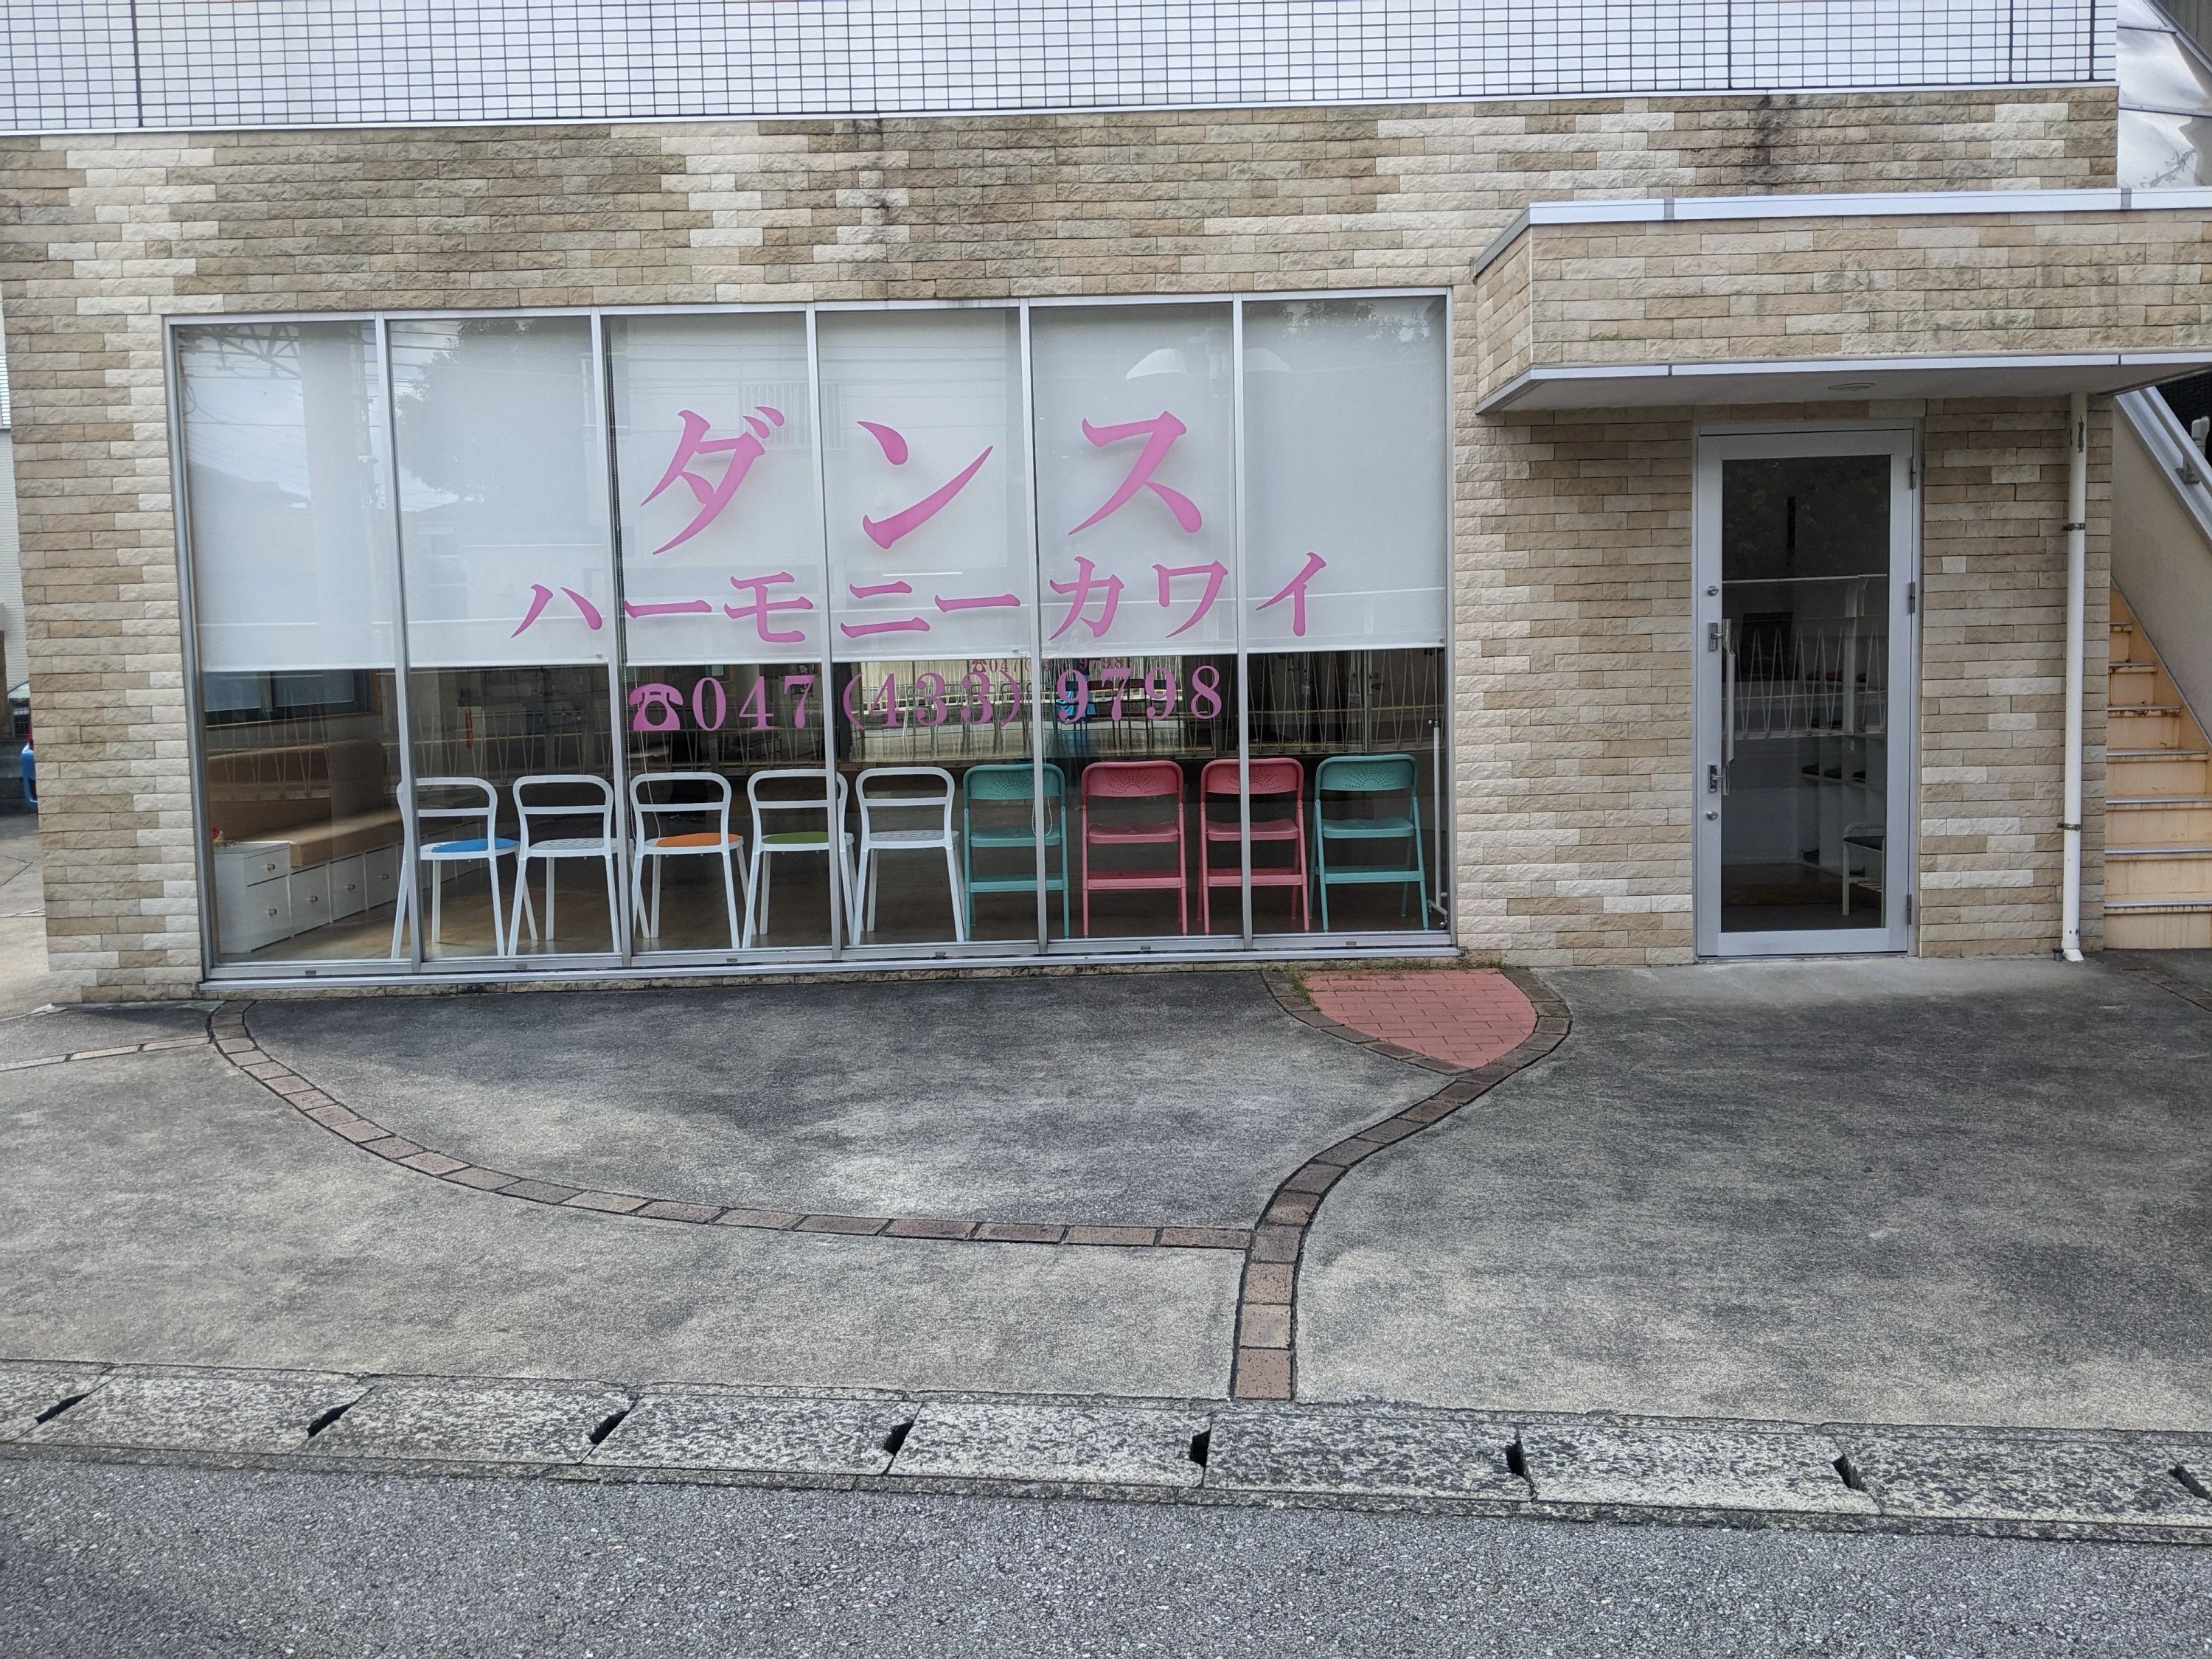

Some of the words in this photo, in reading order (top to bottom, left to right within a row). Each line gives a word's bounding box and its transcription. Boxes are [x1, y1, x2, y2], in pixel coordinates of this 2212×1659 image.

[640, 406, 1203, 554] ダンス
[511, 552, 1326, 644] ハーモニーカワイ
